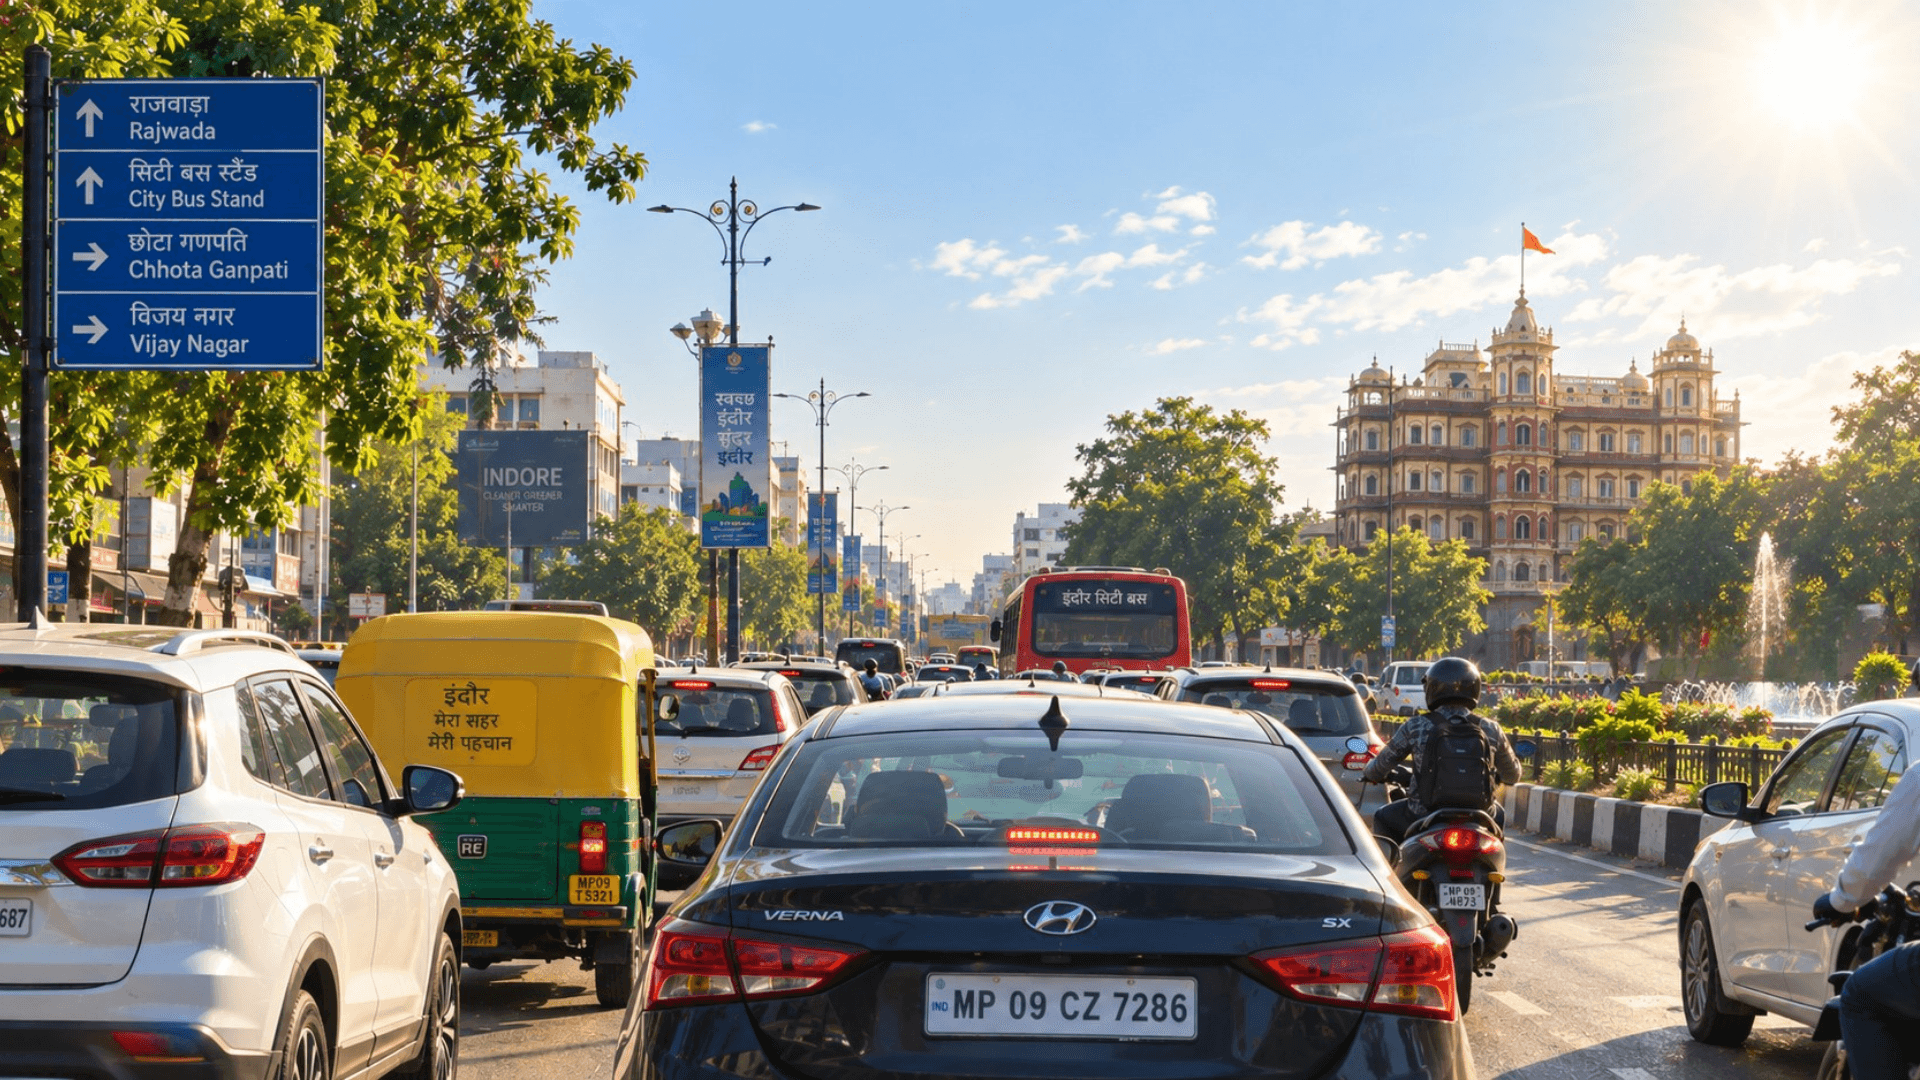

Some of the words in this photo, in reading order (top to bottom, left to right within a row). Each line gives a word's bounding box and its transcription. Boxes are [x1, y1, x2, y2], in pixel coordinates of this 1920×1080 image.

[129, 96, 210, 117] राजवाड़ा
[129, 121, 216, 144] Rajwada
[129, 158, 173, 181] सिटी
[180, 165, 212, 181] बस
[218, 157, 258, 181] स्टैंड
[130, 190, 165, 211] City
[172, 190, 205, 207] Bus
[211, 190, 263, 207] Stand
[128, 228, 173, 251] छोटा
[179, 228, 248, 251] गणपति
[130, 260, 202, 278] Chhota
[210, 260, 287, 283] Ganpati
[130, 301, 186, 325] विजय
[194, 308, 235, 325] नगर
[130, 334, 181, 357] Vijay
[188, 335, 249, 357] Nagar
[484, 467, 562, 486] INDORE
[1094, 588, 1124, 605] सिटी
[1126, 592, 1148, 606] बस
[444, 682, 490, 707] इंदौर
[434, 710, 460, 727] मेरा
[466, 715, 499, 729] सहर
[428, 732, 455, 750] मेरी
[460, 737, 512, 751] पहचान
[461, 842, 483, 855] RE
[0, 908, 28, 928] 687
[764, 910, 844, 921] VERNA
[1321, 917, 1352, 929] SX
[931, 1001, 949, 1012] IND
[954, 990, 995, 1019] MP
[1010, 991, 1046, 1020] 09
[1060, 991, 1100, 1020] CZ
[1114, 992, 1187, 1023] 7286
